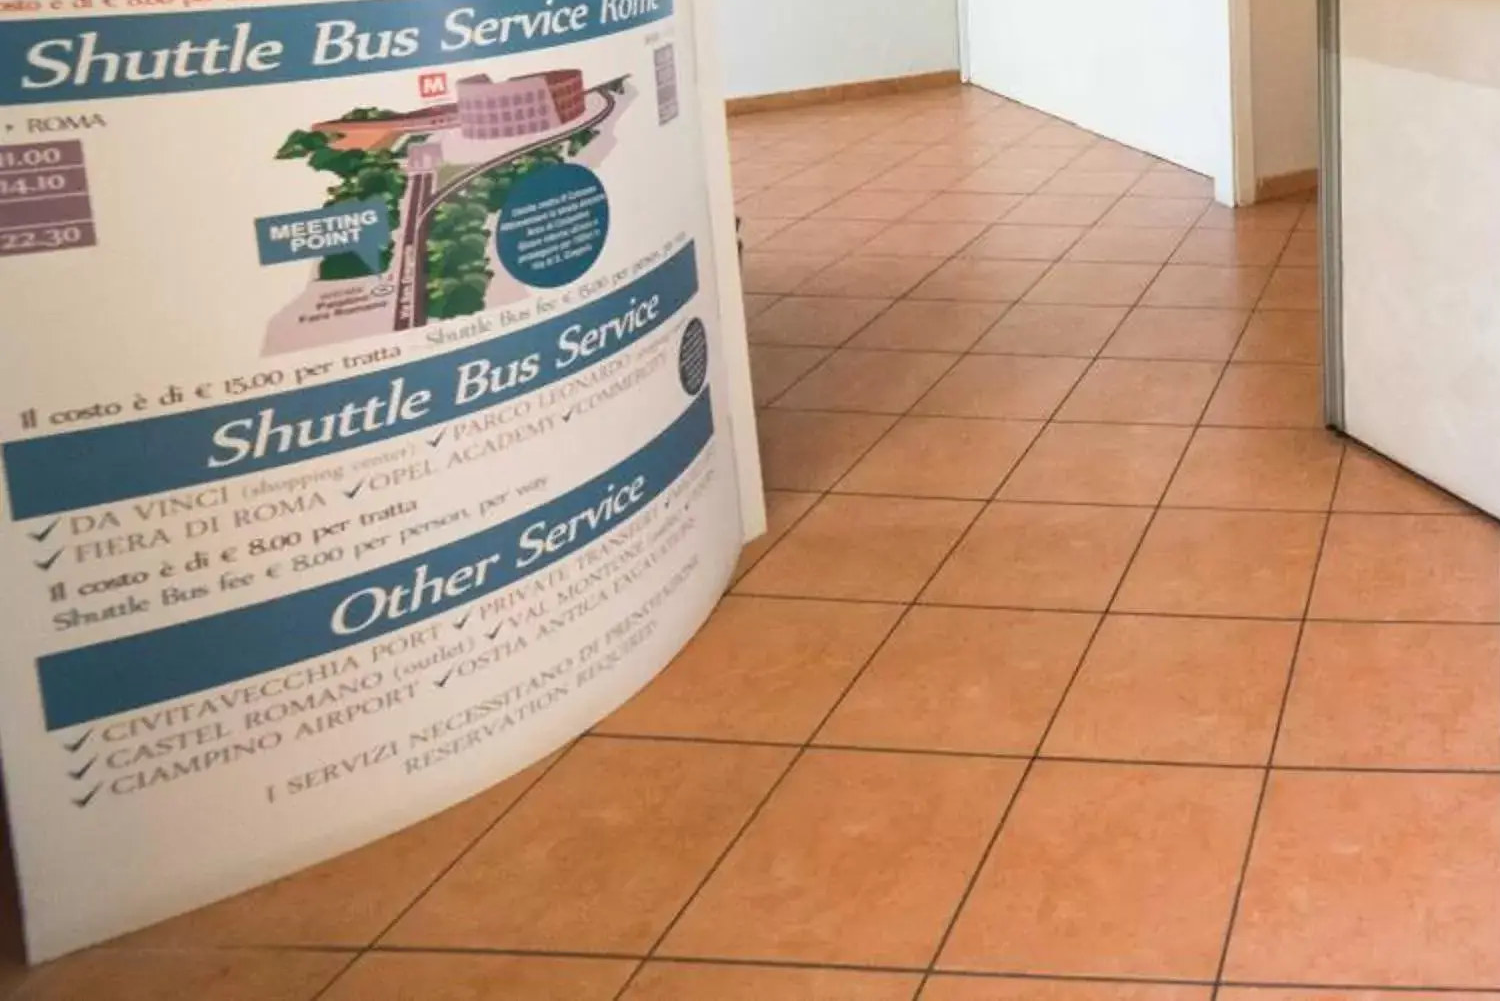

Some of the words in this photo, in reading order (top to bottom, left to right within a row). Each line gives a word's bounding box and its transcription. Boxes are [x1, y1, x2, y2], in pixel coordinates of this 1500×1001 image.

[21, 21, 285, 91] Shuttle
[311, 19, 419, 67] Bus
[27, 113, 108, 134] ROMA
[268, 209, 379, 241] MEETING
[289, 228, 364, 253] POINT
[19, 407, 39, 430] Il
[48, 400, 123, 426] costo
[132, 393, 149, 411] è
[159, 384, 184, 407] di
[194, 381, 214, 399] €
[224, 369, 285, 396] 15.00
[294, 359, 335, 386] per
[342, 344, 402, 371] tratta
[207, 376, 432, 469] Shuttle
[454, 351, 542, 406] Bus
[555, 293, 661, 370] Service
[69, 510, 122, 536] DA
[133, 485, 231, 523] VINCI
[453, 400, 532, 441] PARCO
[74, 528, 172, 564] FIERA
[184, 517, 221, 540] DI
[232, 491, 328, 530] ROMA
[368, 460, 439, 494] OPEL
[49, 581, 67, 603] Il
[77, 571, 150, 599] costo
[159, 561, 175, 580] è
[184, 550, 210, 574] di
[220, 544, 240, 564] €
[247, 530, 303, 559] 8.00
[312, 518, 351, 547] per
[358, 498, 419, 528] tratta
[51, 597, 152, 633] Shuttle
[160, 582, 211, 607] Bus
[218, 570, 255, 594] fee
[264, 562, 284, 580] €
[291, 545, 345, 574] 8.00
[352, 533, 392, 562] per
[330, 551, 501, 637] Other
[515, 473, 646, 570] Service
[101, 655, 361, 744] CIVITAVECCHIA
[371, 621, 444, 664] PORT
[105, 723, 233, 771] CASTEL
[244, 671, 385, 731] ROMANO
[110, 732, 283, 797] CIAMPINO
[294, 680, 421, 742] AIRPORT
[286, 741, 400, 796] SERVIZI
